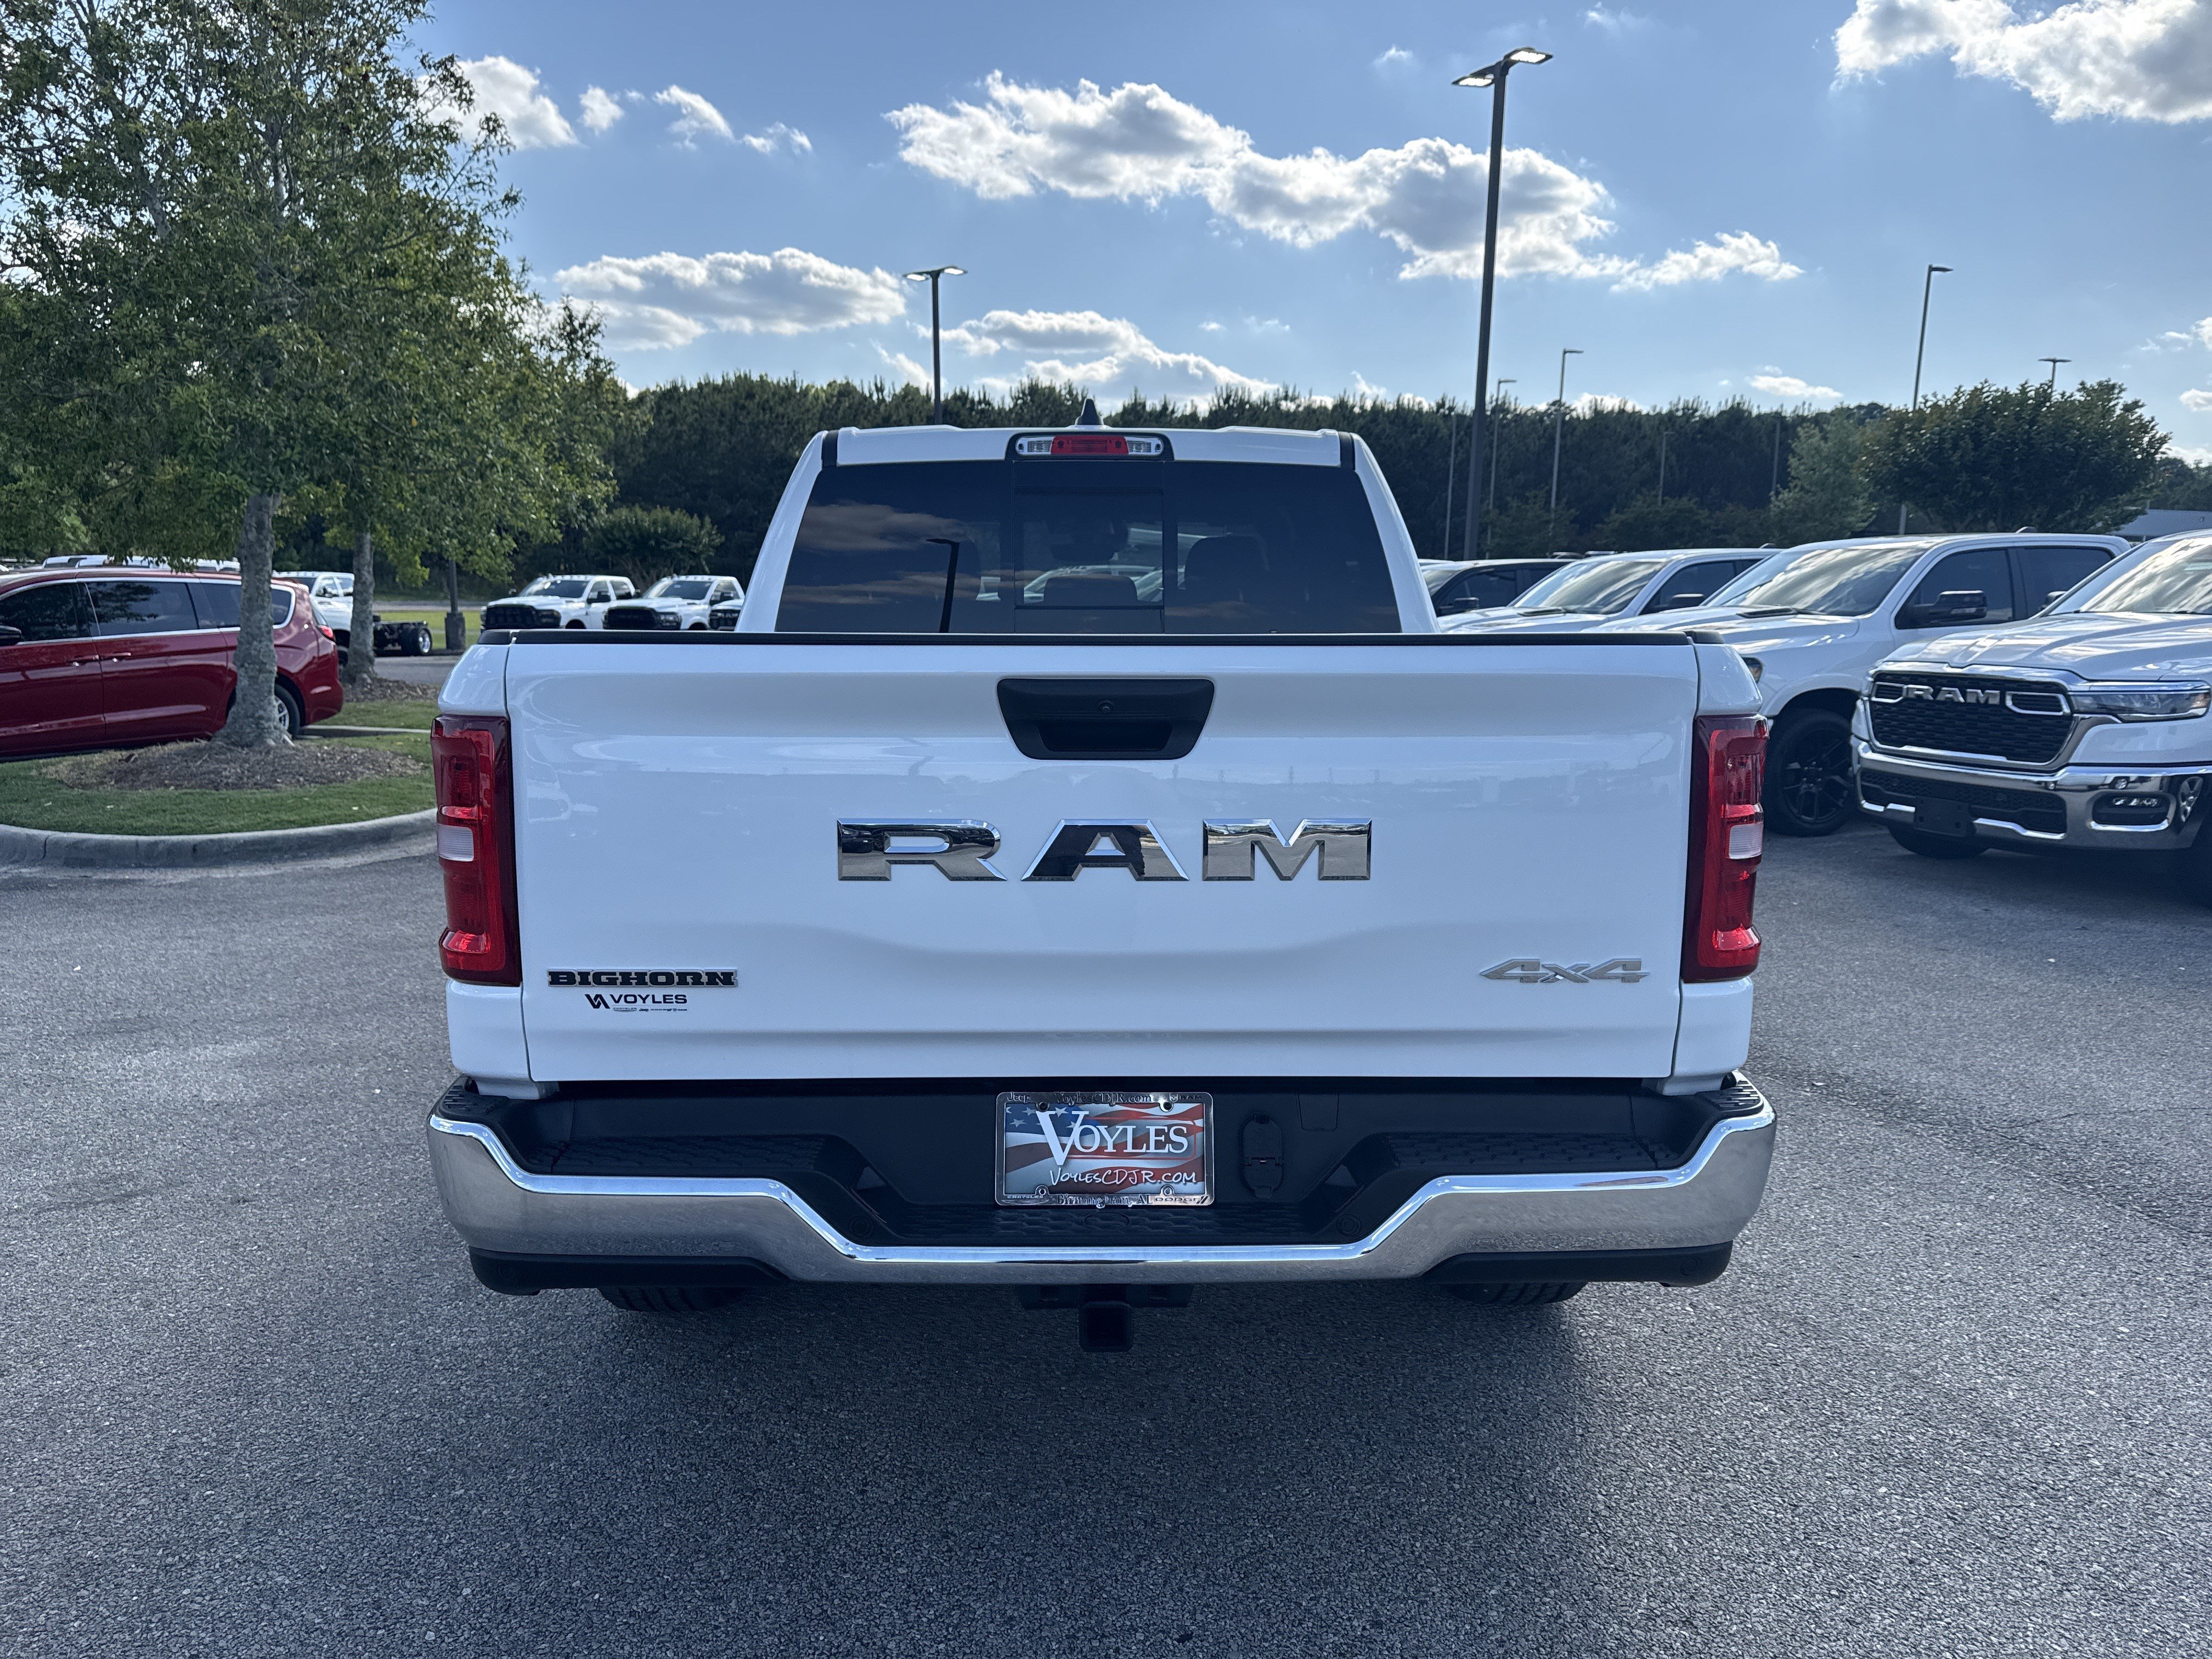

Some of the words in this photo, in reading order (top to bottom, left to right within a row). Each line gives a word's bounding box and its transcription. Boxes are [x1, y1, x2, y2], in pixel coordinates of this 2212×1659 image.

[1904, 685, 2000, 704] RAM
[837, 819, 1372, 881] RAM
[548, 969, 738, 988] BIGHORN
[610, 994, 687, 1004] VOYLES
[1007, 1092, 1030, 1104] Jeep
[1054, 1092, 1153, 1107] VoylesCDJR.com
[1036, 1110, 1189, 1166] VOYLES
[1057, 1193, 1133, 1208] Birmingham,
[1136, 1193, 1153, 1204] AL
